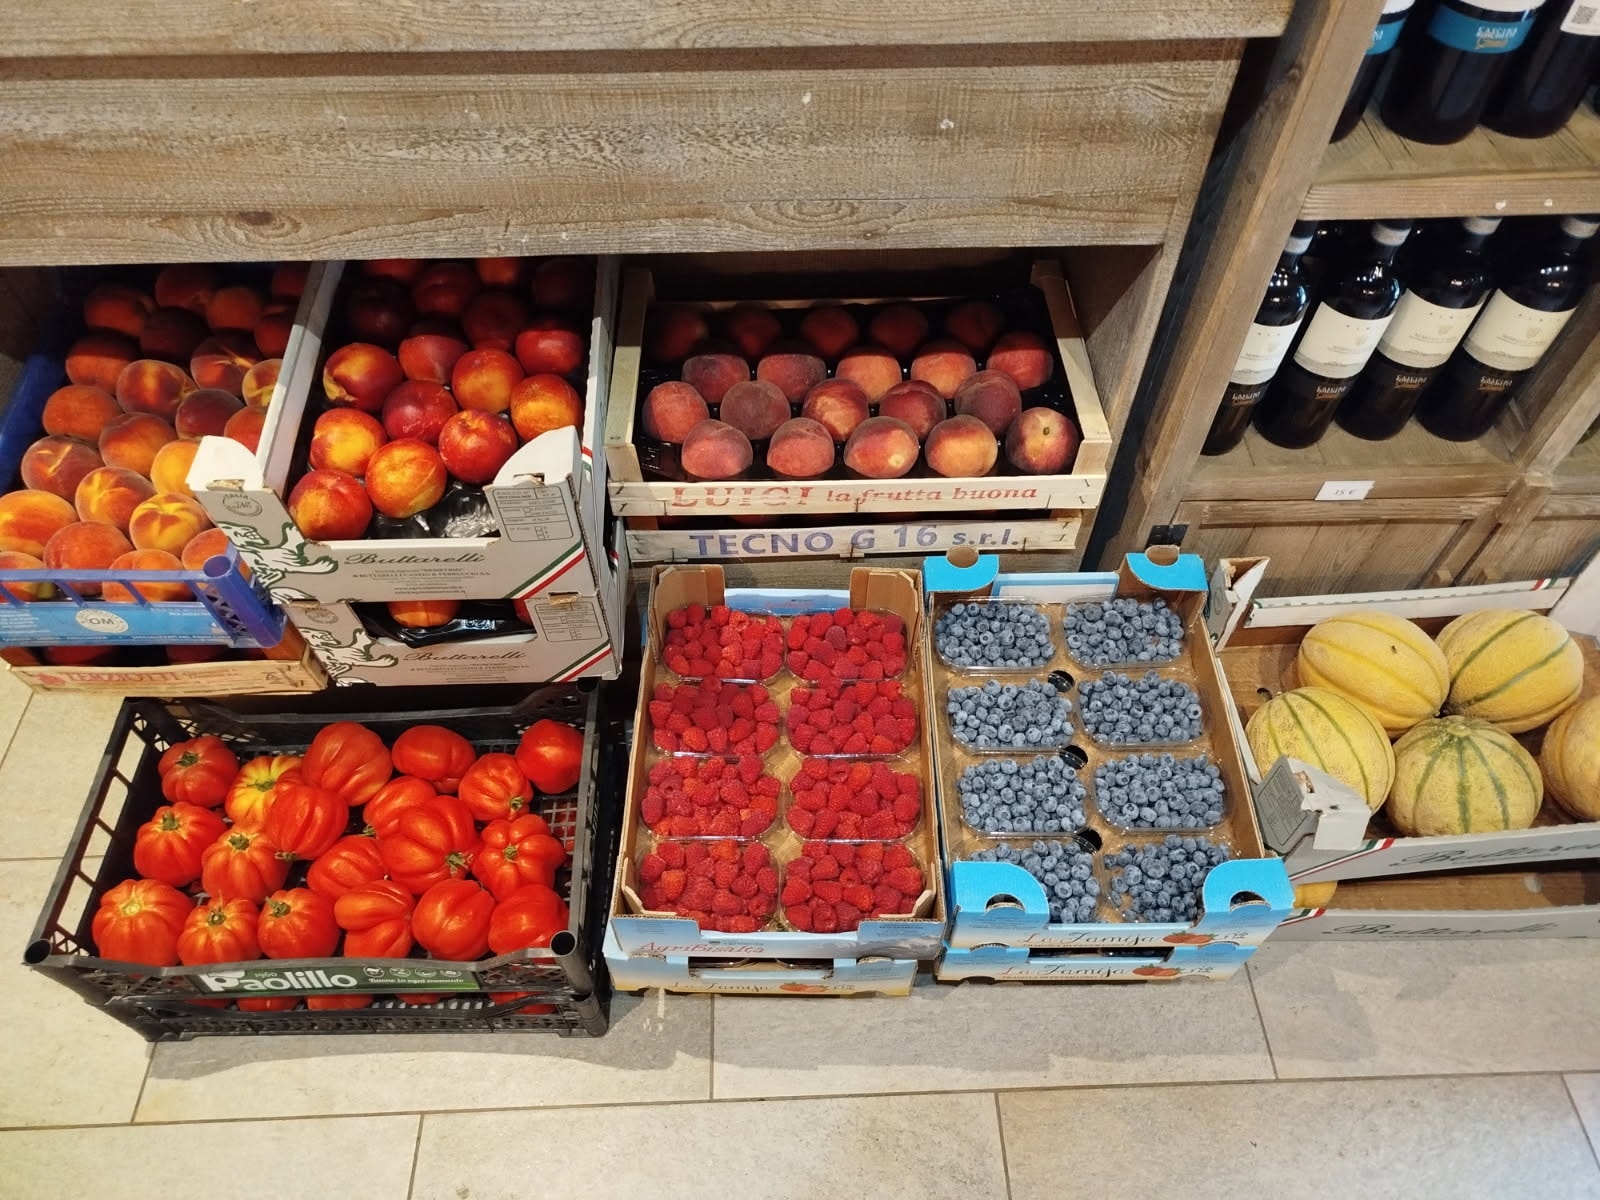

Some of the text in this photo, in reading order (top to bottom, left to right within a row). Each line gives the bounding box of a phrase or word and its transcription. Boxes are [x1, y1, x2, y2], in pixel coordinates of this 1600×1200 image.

[827, 490, 850, 502] la
[853, 488, 942, 505] frutta
[952, 486, 1038, 500] buona
[688, 524, 1019, 557] TECNO G 16 s.r.l.
[343, 552, 486, 565] Buttarelli
[403, 650, 527, 661] Buttarelli
[640, 941, 765, 955] AgriBisalta
[199, 970, 358, 992] Paolillo
